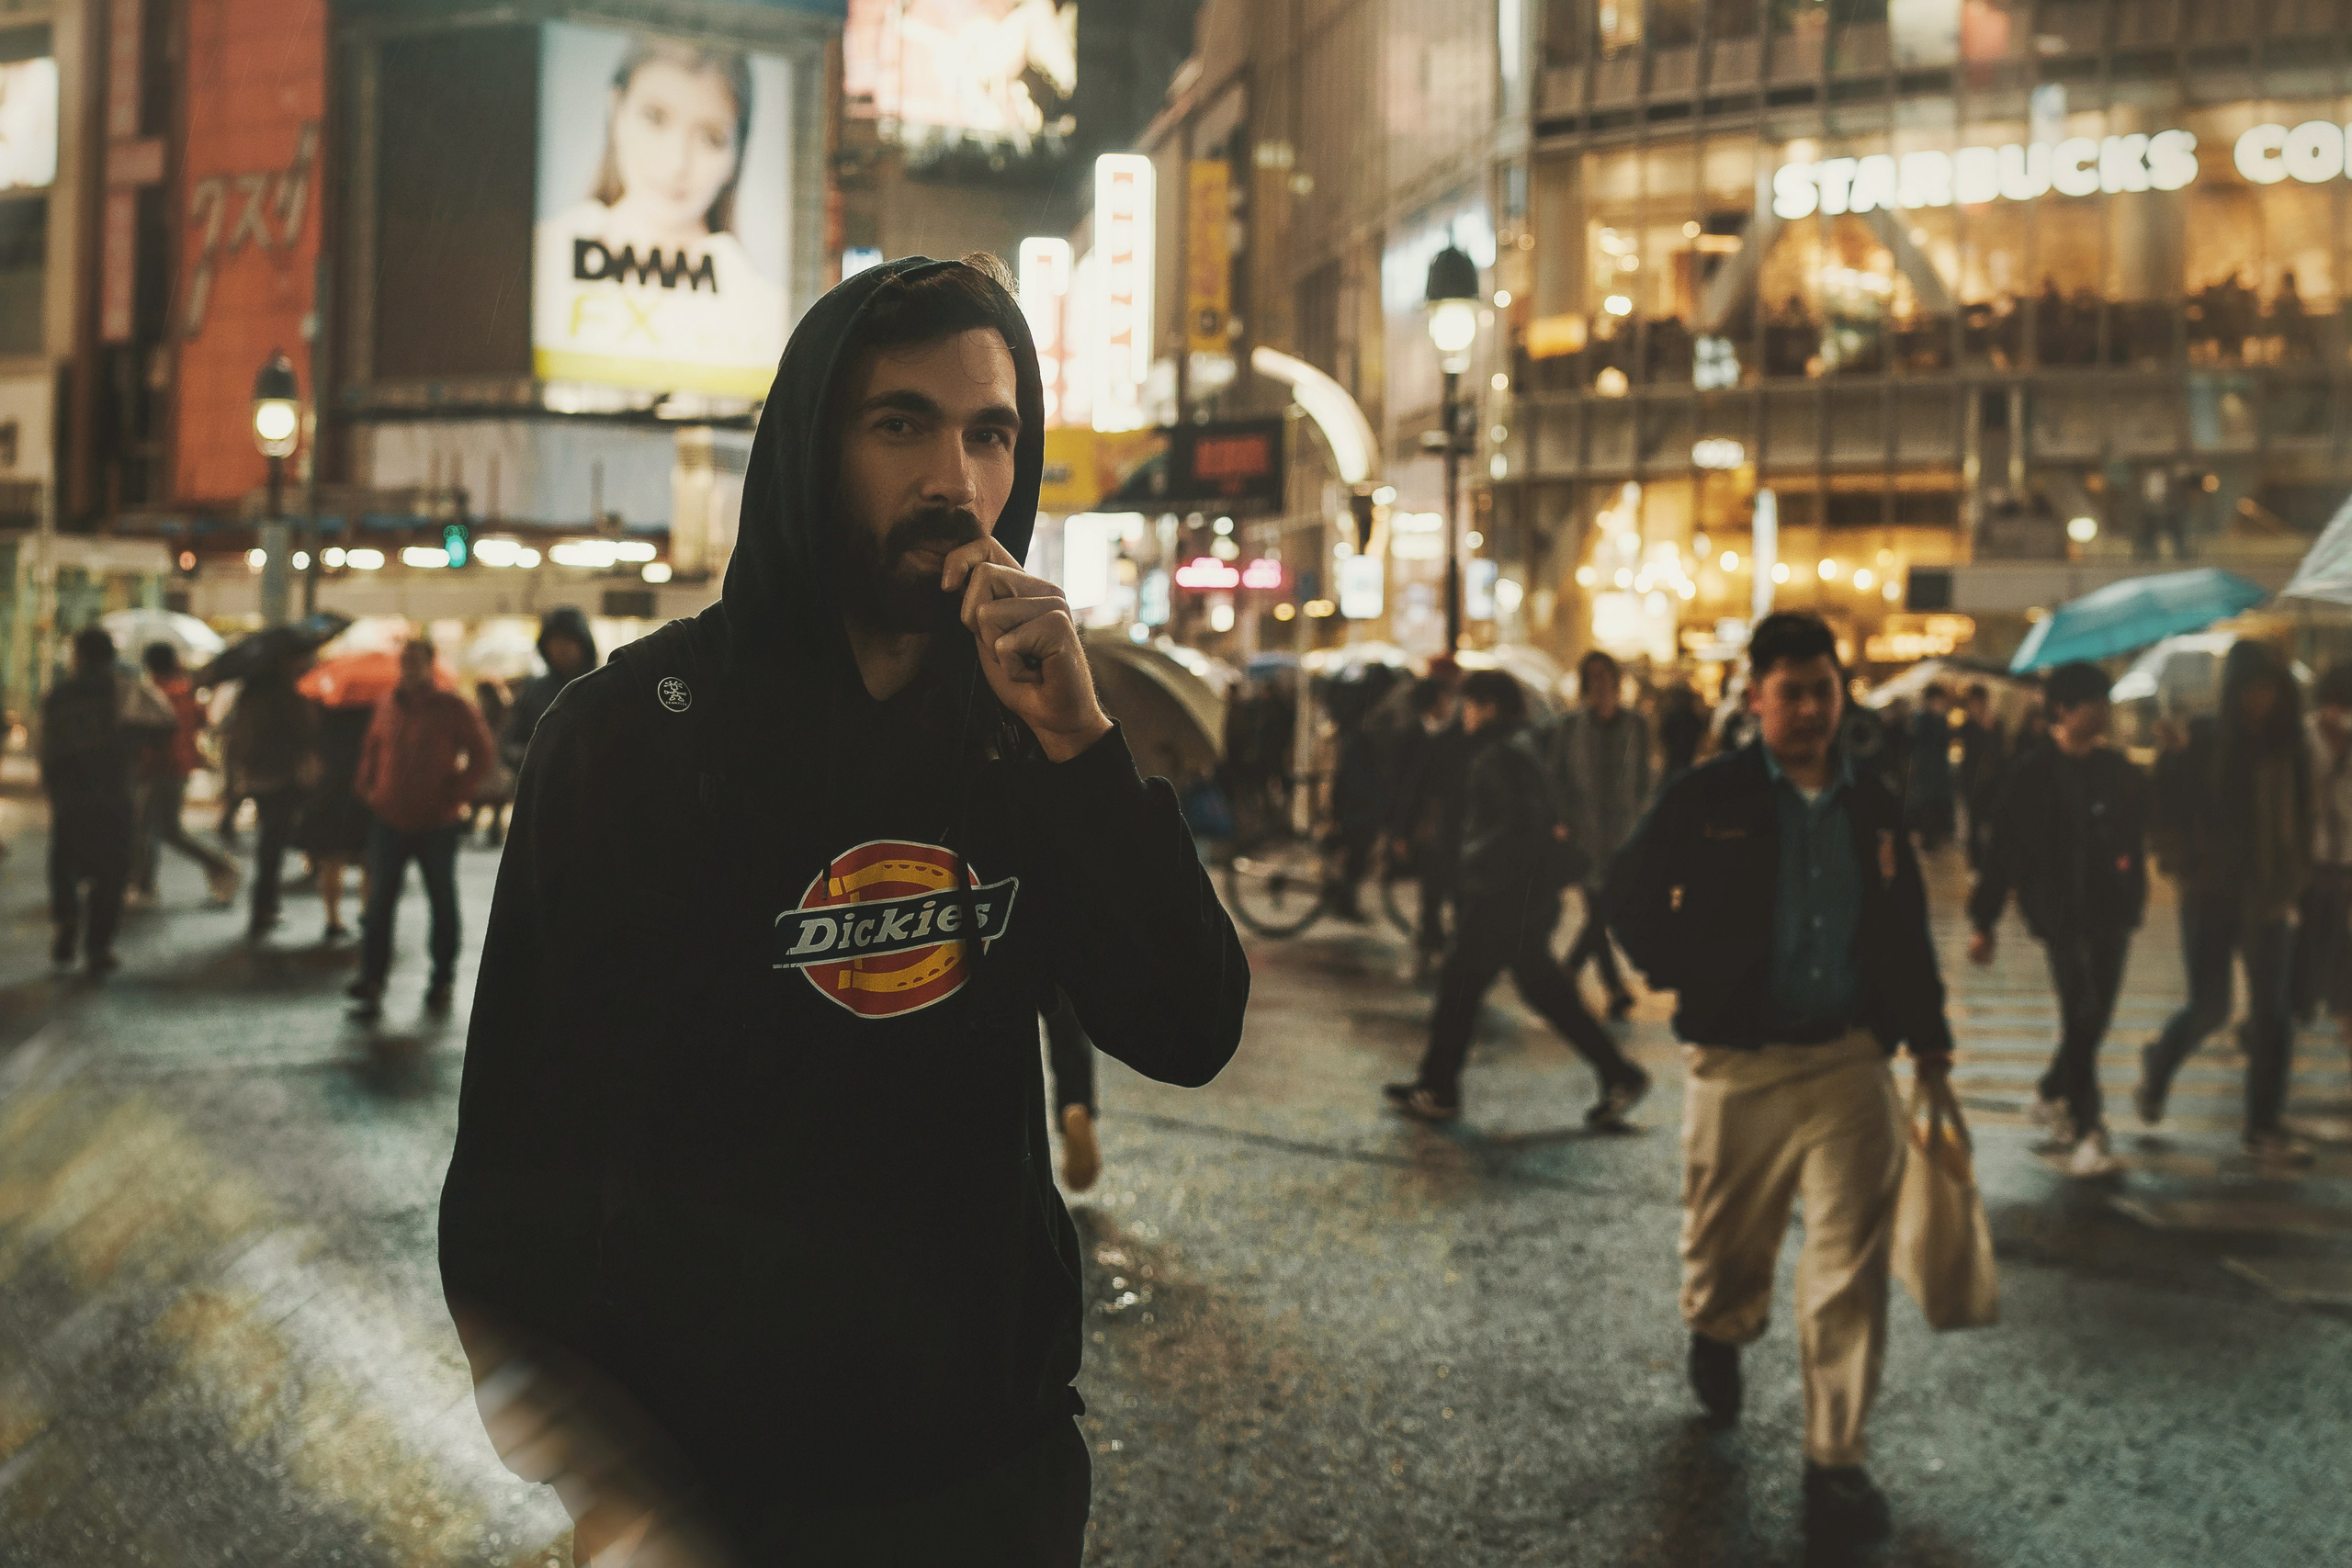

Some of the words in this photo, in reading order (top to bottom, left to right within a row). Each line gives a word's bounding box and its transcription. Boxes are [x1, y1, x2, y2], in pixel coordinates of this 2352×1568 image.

[1772, 129, 2199, 220] STARBUCKS
[2233, 119, 2352, 185] CO
[573, 238, 717, 294] DMM
[569, 294, 660, 344] FX
[786, 900, 991, 955] Dickies
